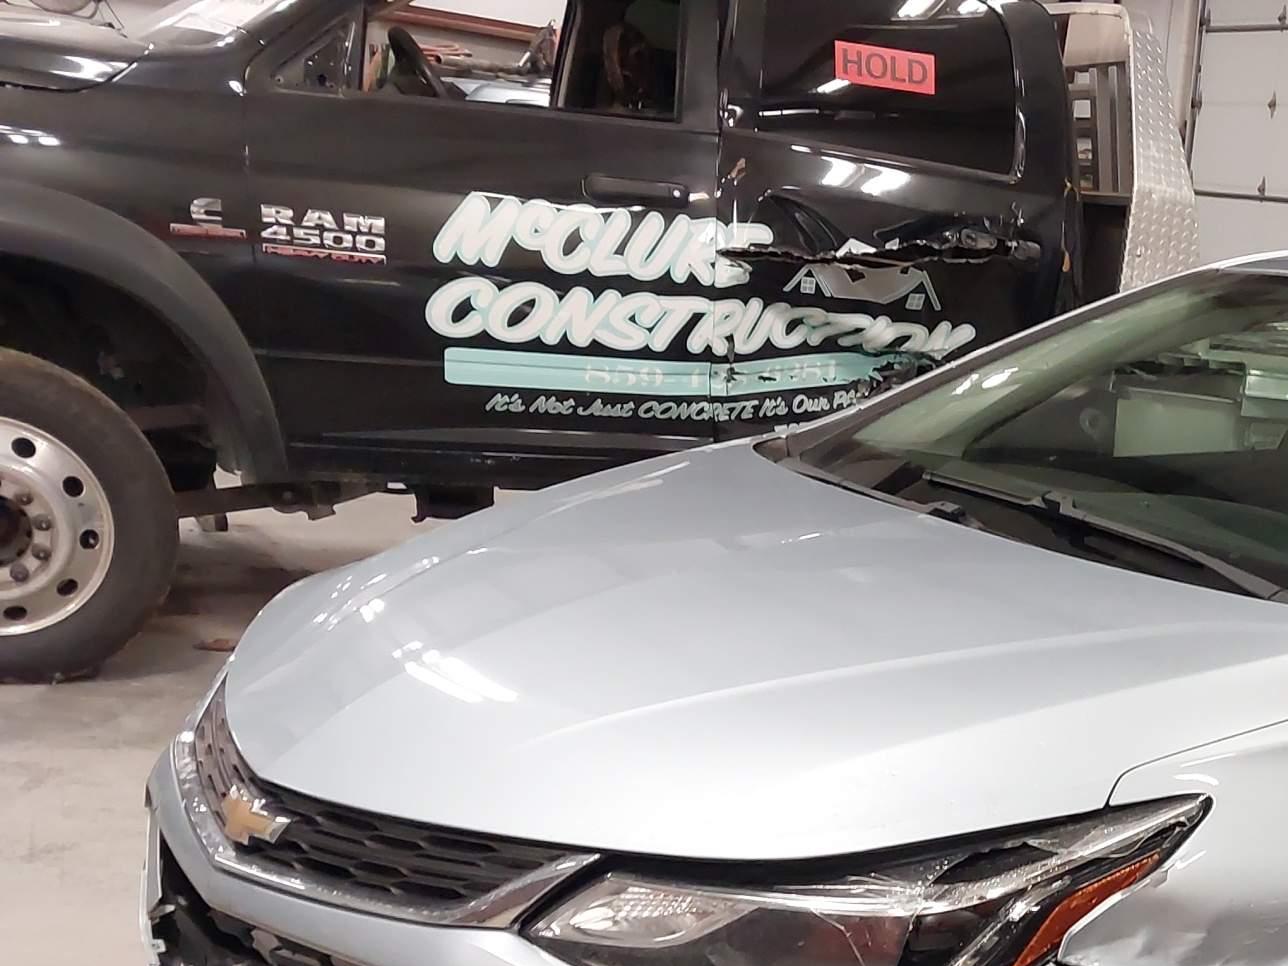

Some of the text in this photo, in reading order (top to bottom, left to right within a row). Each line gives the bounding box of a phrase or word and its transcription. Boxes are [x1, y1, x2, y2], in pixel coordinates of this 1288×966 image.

[841, 47, 929, 84] HOLD
[260, 203, 386, 235] RAM
[260, 224, 386, 252] 4500
[425, 276, 976, 361] CONSTRUCTION
[485, 392, 526, 412] It's
[529, 395, 576, 414] Not
[577, 399, 635, 417] Just
[637, 400, 757, 422] CONCRETE
[758, 395, 789, 417] It's
[792, 393, 831, 415] Our
